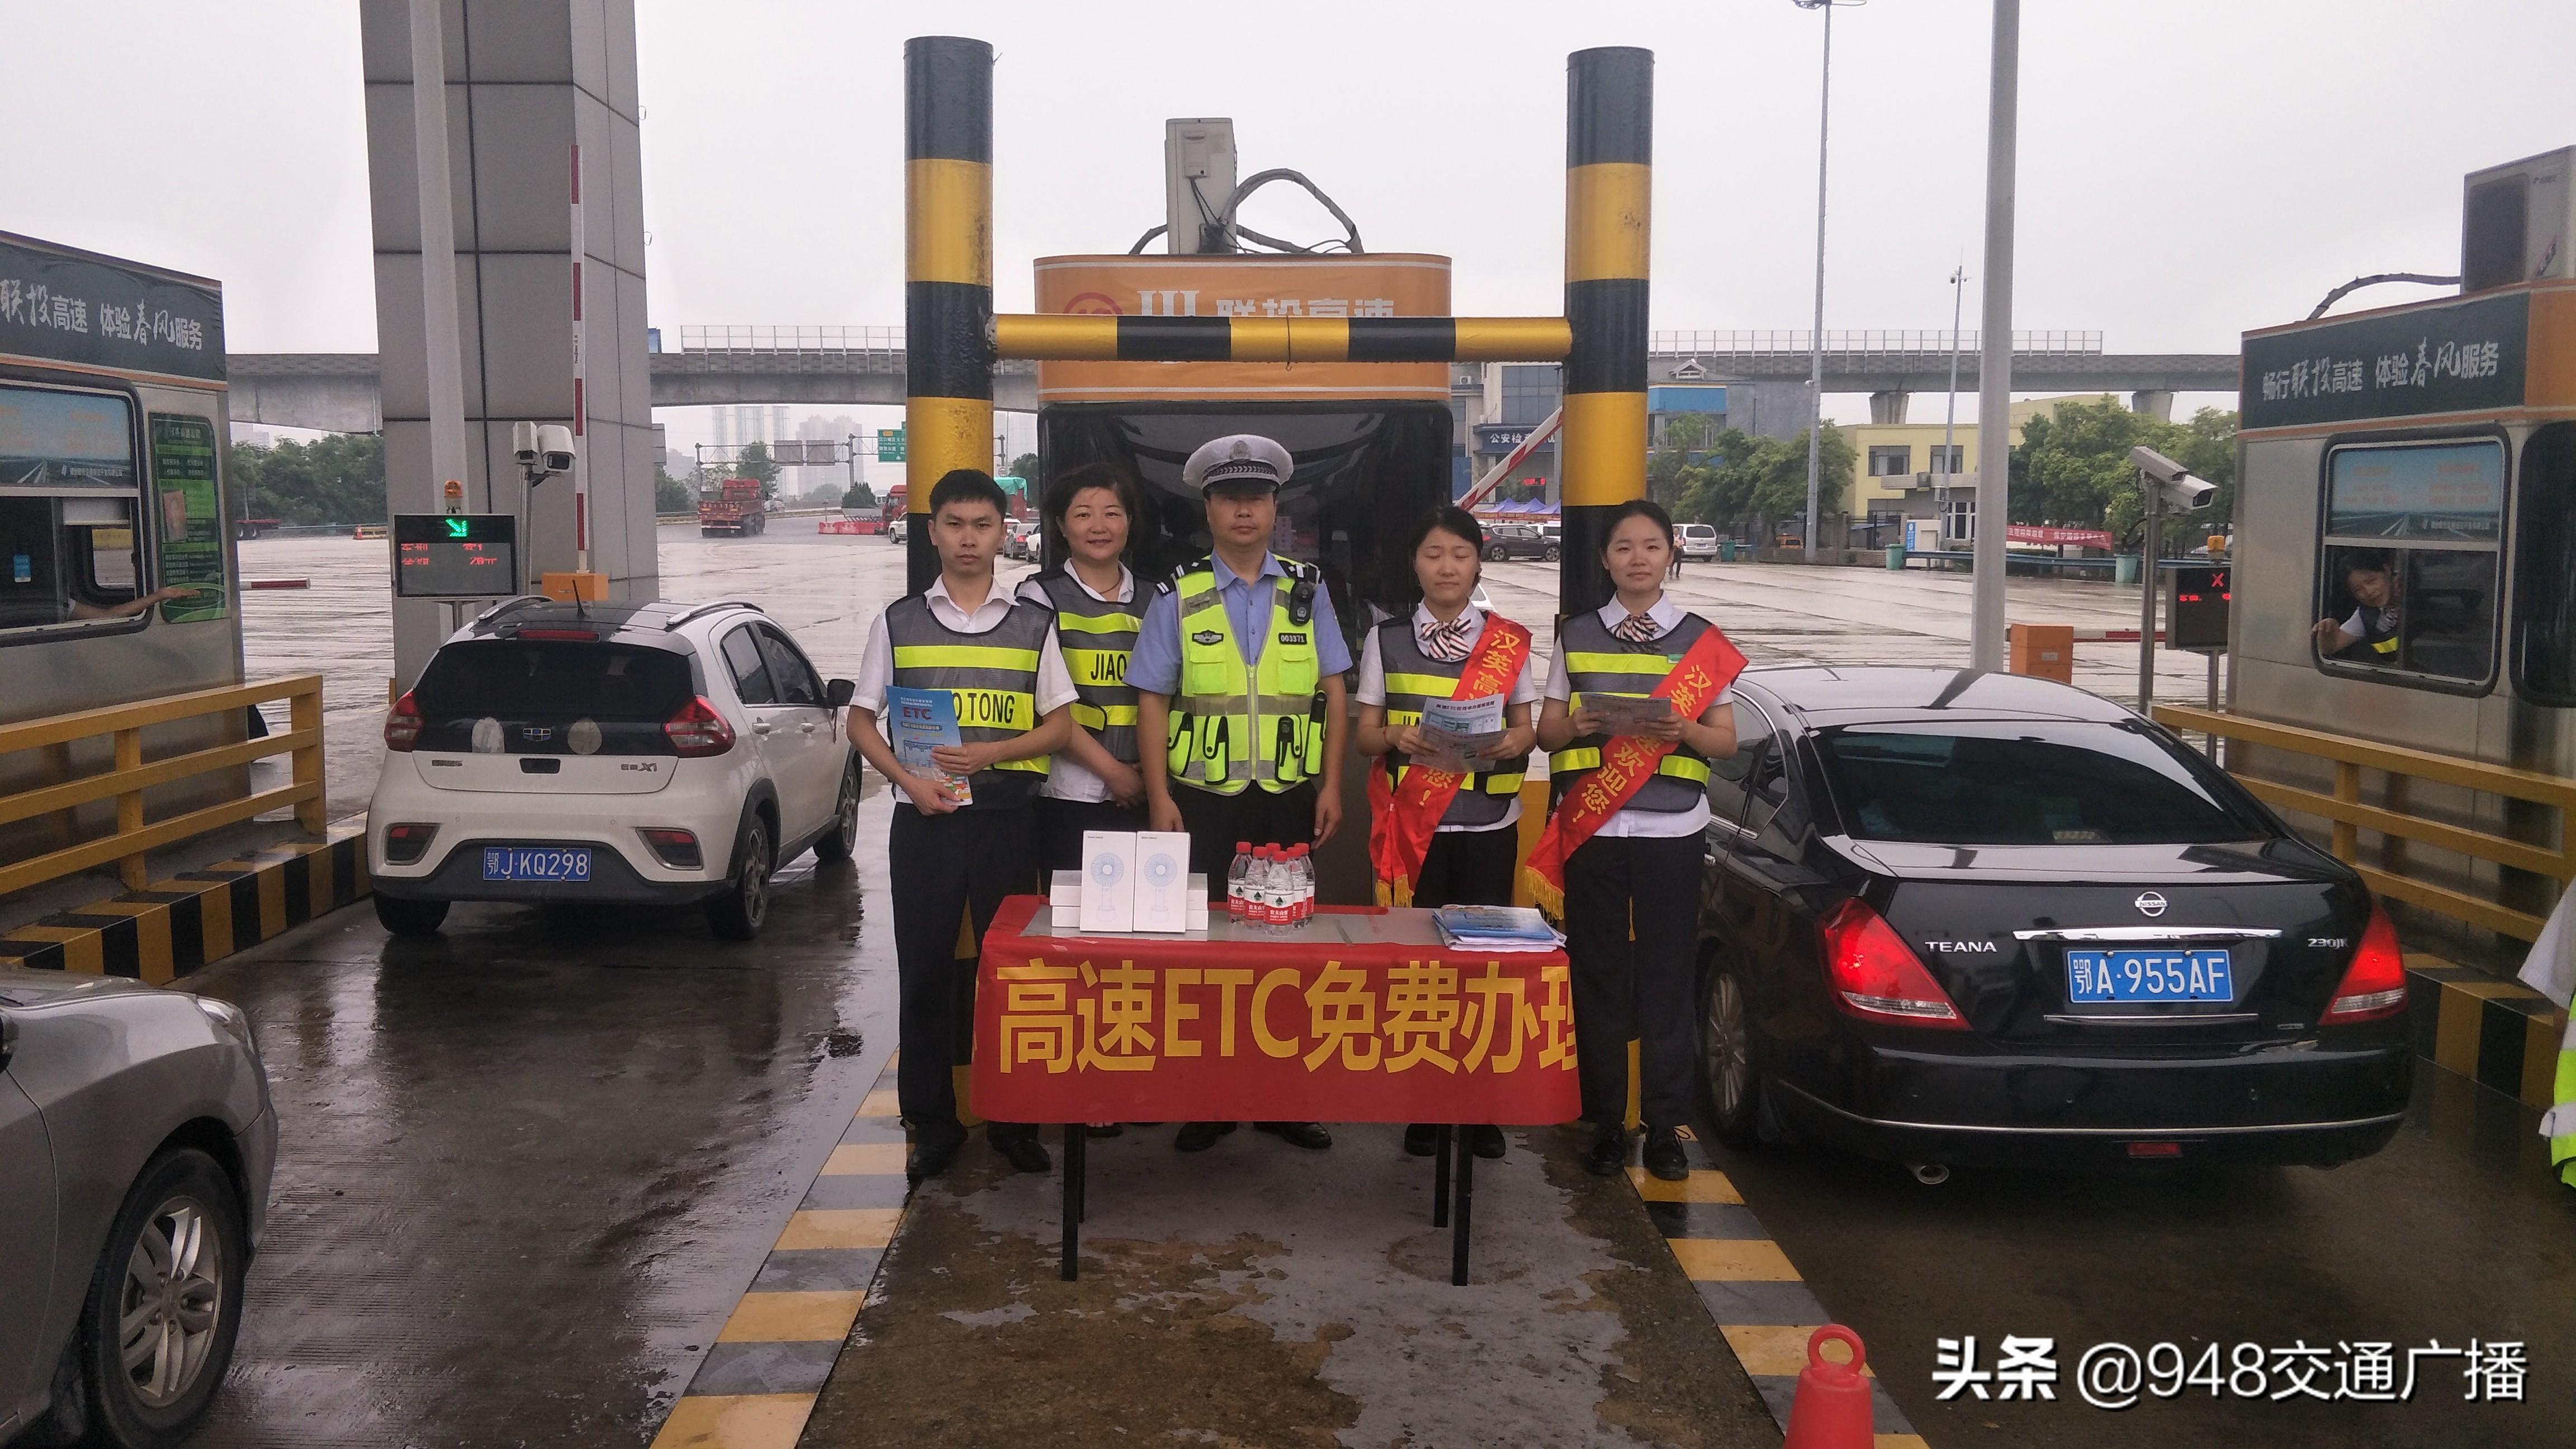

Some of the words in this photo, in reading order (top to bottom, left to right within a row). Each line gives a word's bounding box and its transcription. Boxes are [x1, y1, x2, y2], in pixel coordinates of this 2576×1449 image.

[100, 299, 202, 351] 体验春风服务
[2375, 337, 2499, 389] 体验春风服务
[1090, 653, 1127, 681] JIAO
[903, 707, 932, 720] ETC
[968, 693, 1015, 724] TONG
[1925, 941, 1997, 952] TEANA
[2072, 957, 2225, 995] 鄂A·955AF
